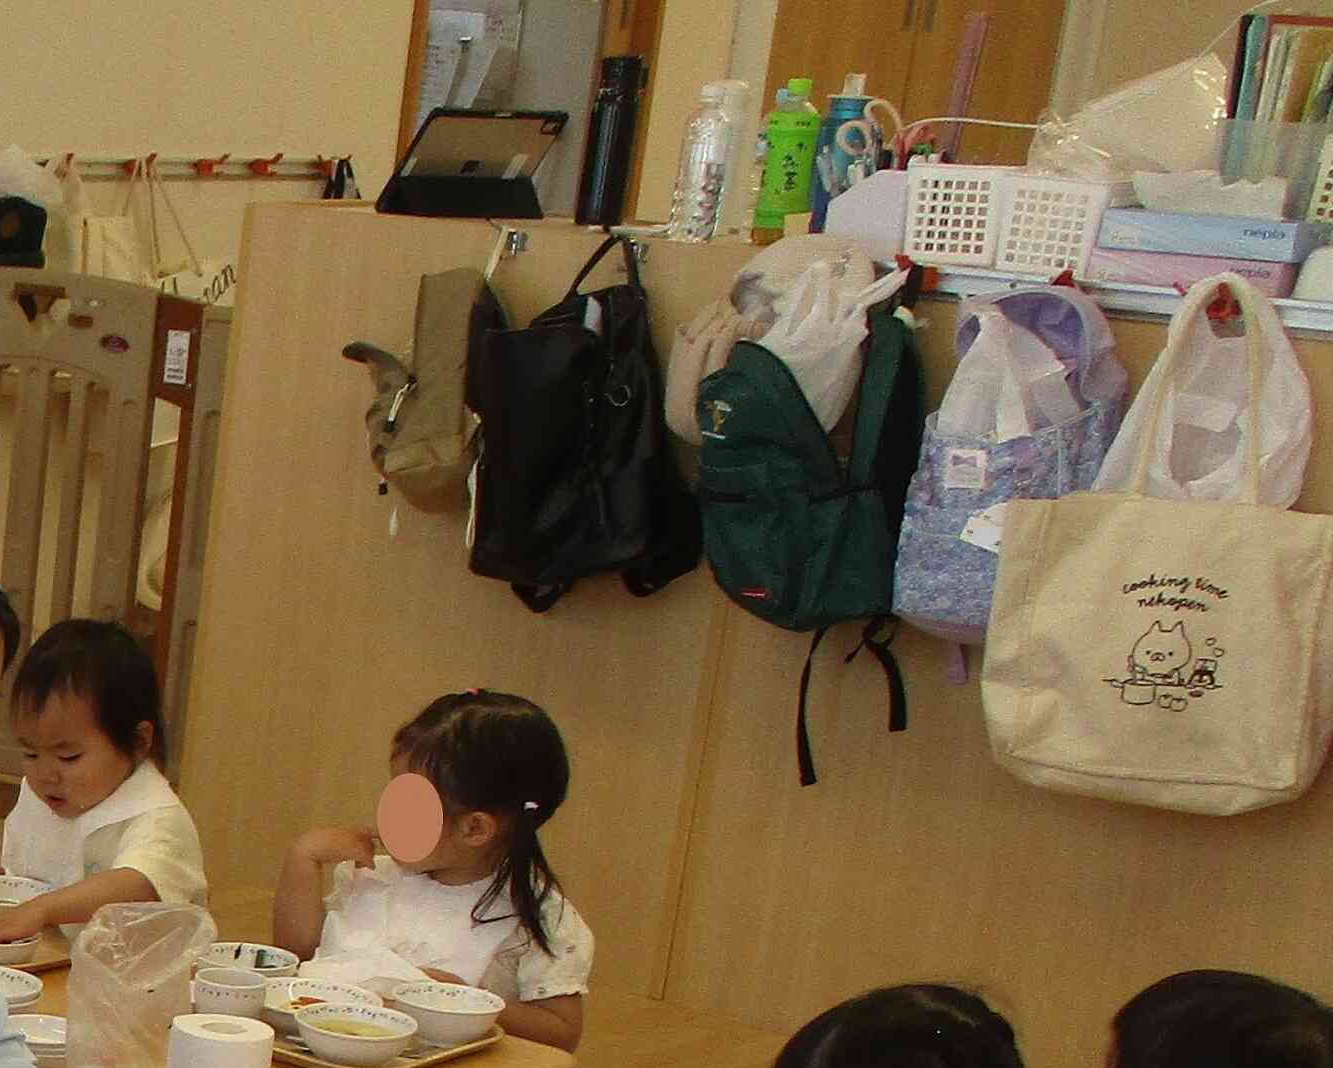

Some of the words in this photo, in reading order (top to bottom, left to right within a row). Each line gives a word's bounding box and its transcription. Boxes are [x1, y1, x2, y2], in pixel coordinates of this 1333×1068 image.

[1243, 228, 1286, 241] nepia
[1123, 574, 1192, 594] cooking
[1194, 577, 1229, 599] time
